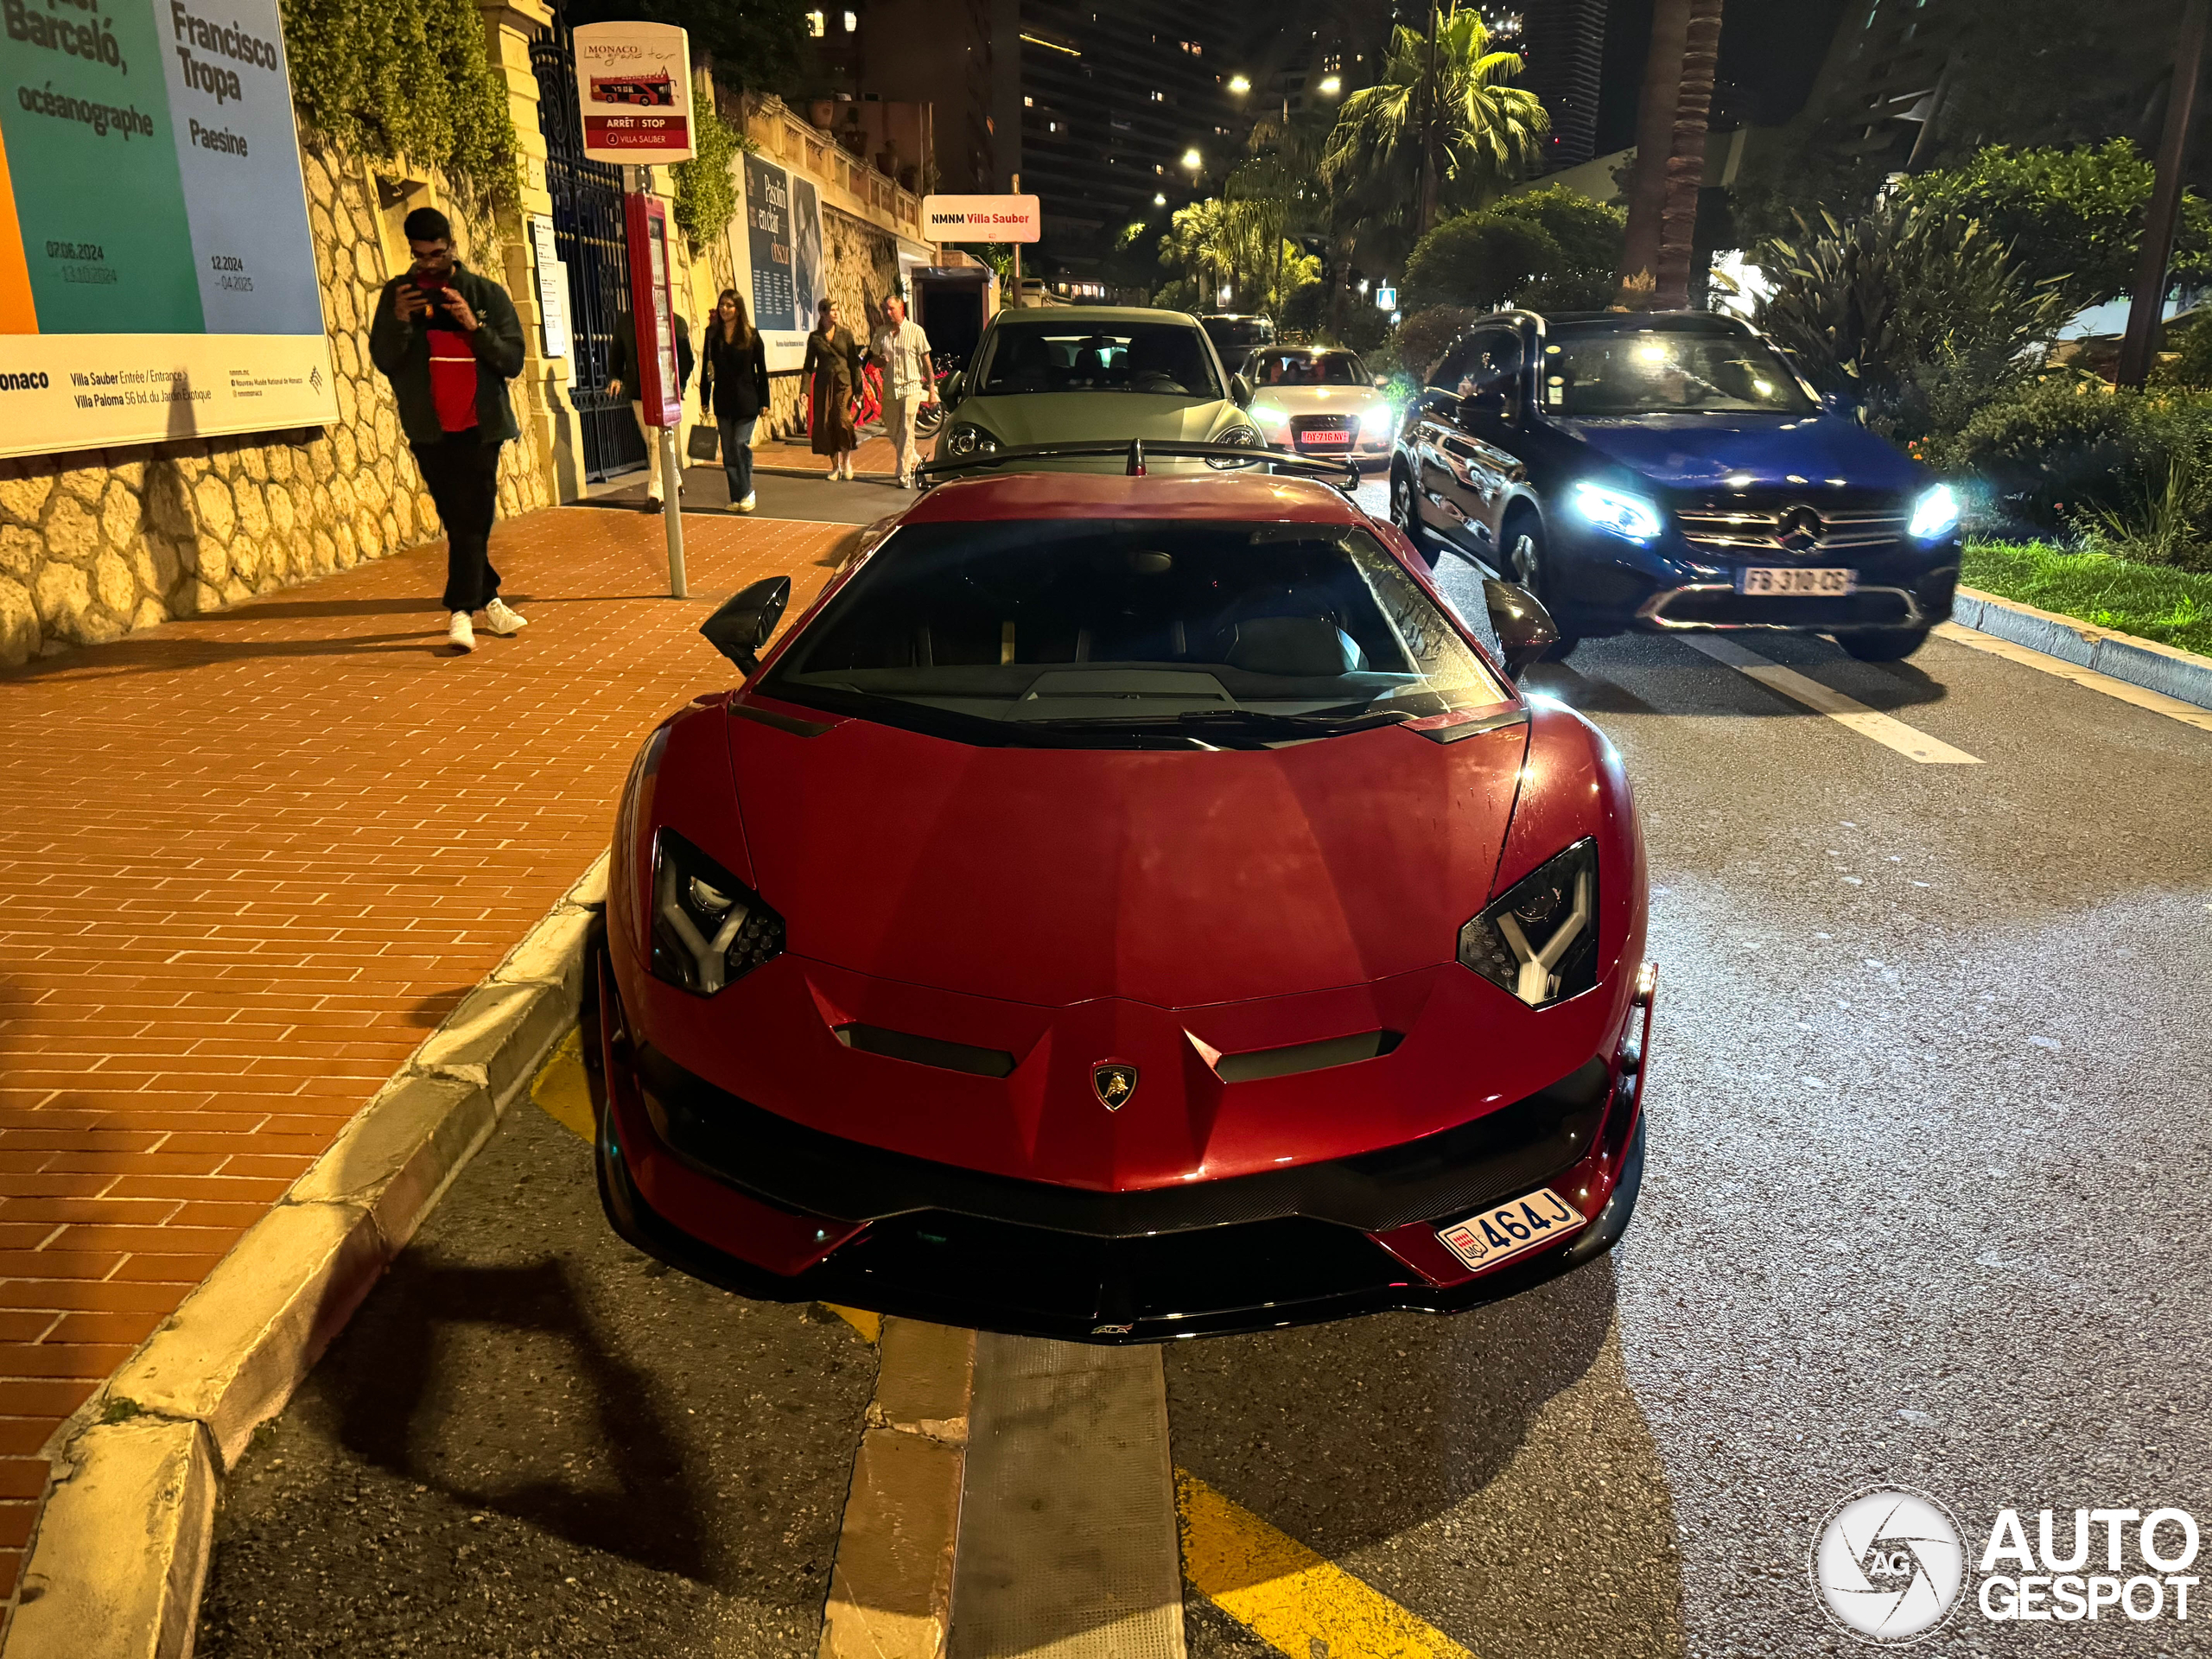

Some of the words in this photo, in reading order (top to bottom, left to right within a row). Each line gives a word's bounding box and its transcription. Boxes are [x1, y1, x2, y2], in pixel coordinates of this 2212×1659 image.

[3, 0, 128, 76] Barceló,
[172, 2, 277, 71] Francisco
[176, 45, 242, 105] Tropa
[17, 80, 154, 142] océanographe
[607, 117, 634, 128] ARRÊT
[642, 118, 665, 128] STOP
[189, 118, 248, 157] Paesine
[639, 135, 665, 143] SAUBER
[931, 213, 964, 224] NMNM
[967, 213, 990, 224] Villa
[992, 213, 1029, 224] Sauber
[212, 256, 243, 271] 12.2024
[0, 372, 49, 391] onaco
[70, 372, 89, 386] Villa
[90, 372, 118, 386] Sauber
[119, 370, 144, 384] Entrée
[149, 370, 182, 383] Entrance
[74, 394, 93, 409] Villa
[93, 392, 124, 407] Paloma
[124, 391, 136, 405] 56
[136, 391, 149, 404] bd.
[149, 391, 160, 404] du
[161, 389, 182, 403] Jardin
[182, 387, 212, 404] Exotique
[1478, 1192, 1573, 1249] 464J
[1462, 1244, 1483, 1256] MC
